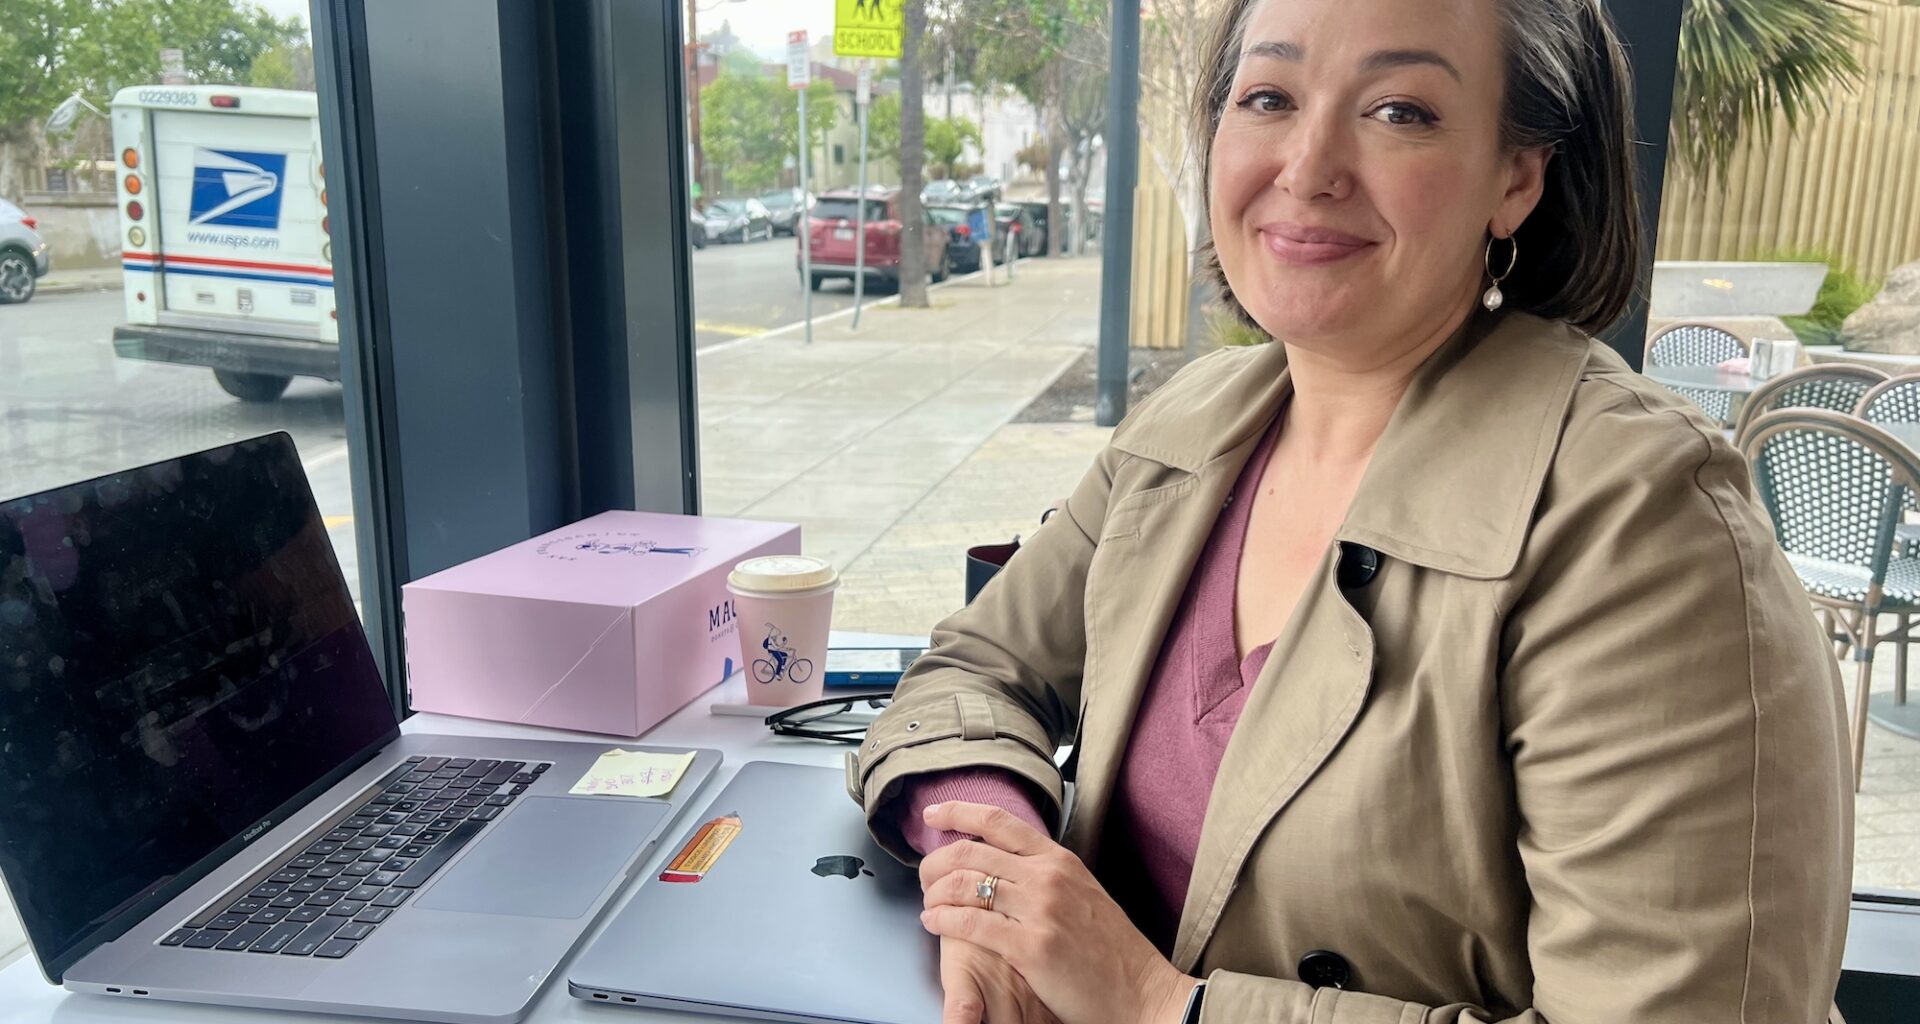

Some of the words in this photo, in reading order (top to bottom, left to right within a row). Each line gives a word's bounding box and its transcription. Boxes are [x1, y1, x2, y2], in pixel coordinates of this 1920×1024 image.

[838, 32, 895, 50] SCHOOL
[138, 90, 197, 106] 0229383
[187, 231, 280, 249] www.usps.com
[243, 824, 263, 842] MacBook
[262, 819, 272, 829] Pro
